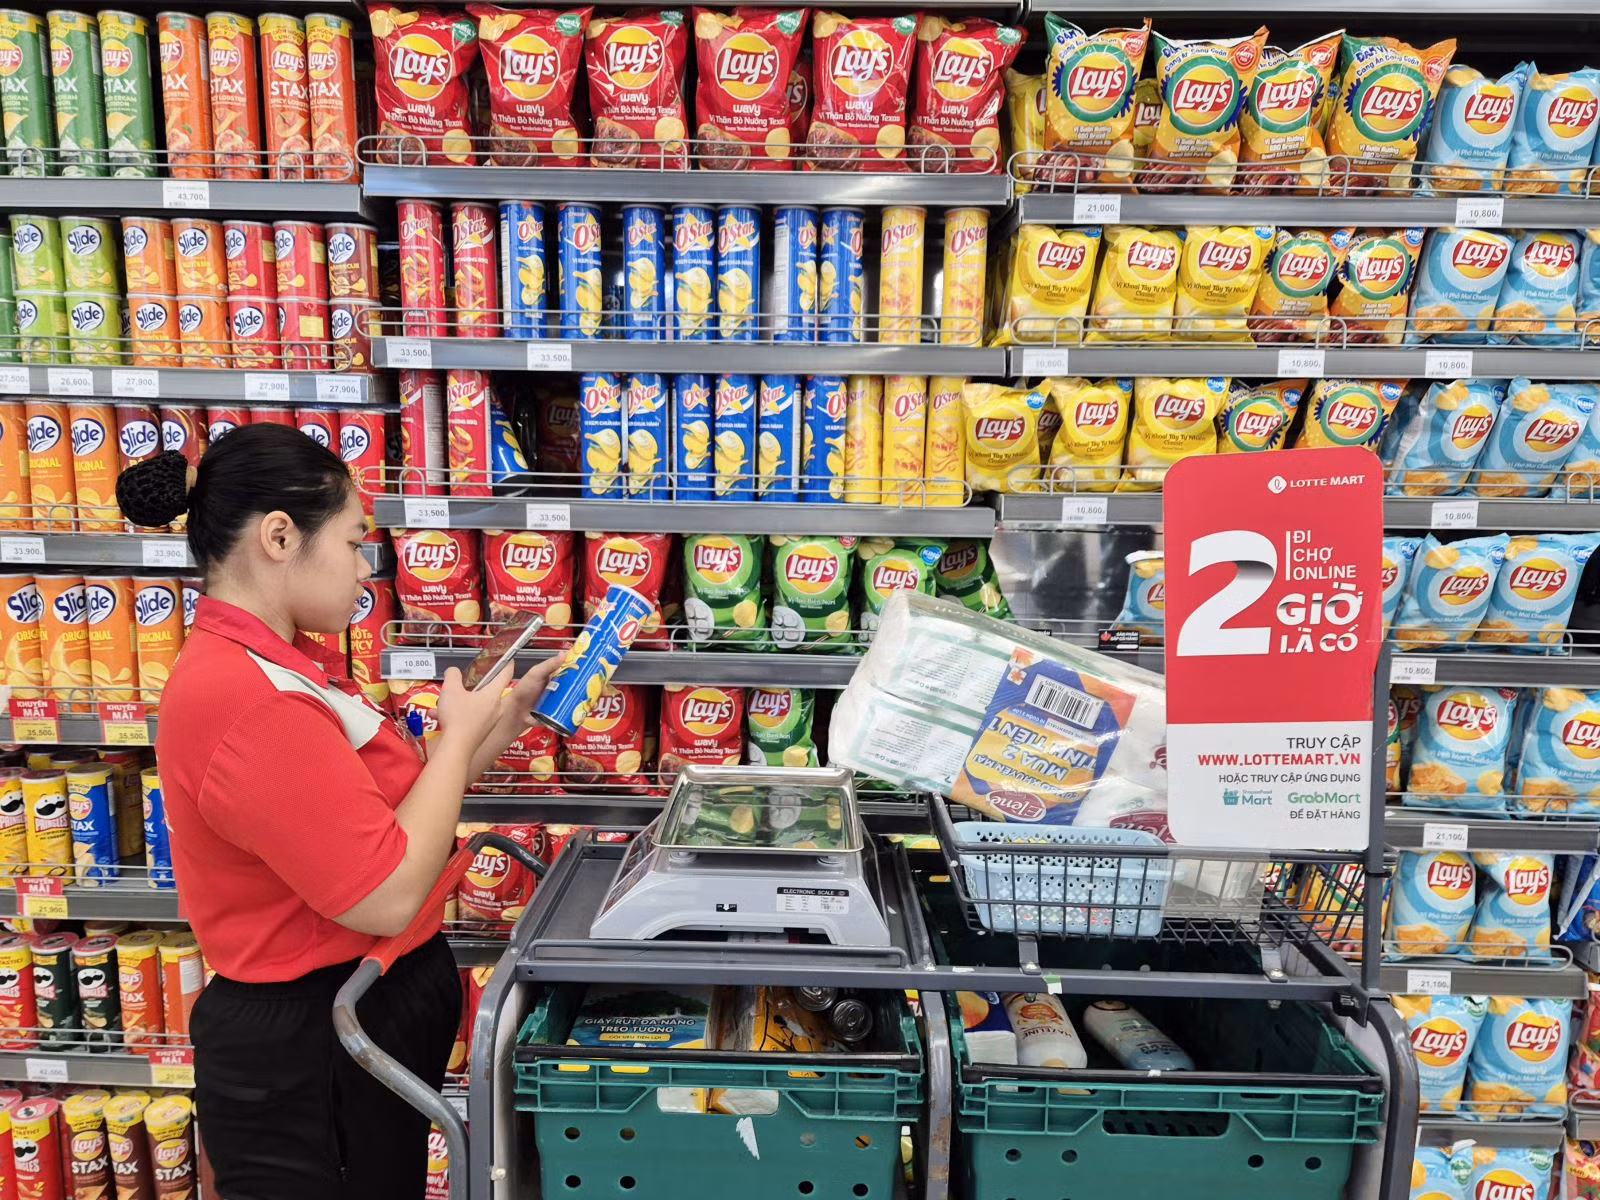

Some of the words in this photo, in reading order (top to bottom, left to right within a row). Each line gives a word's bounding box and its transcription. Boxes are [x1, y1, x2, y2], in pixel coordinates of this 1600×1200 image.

[394, 47, 449, 86] Lay's
[502, 47, 557, 86] Lay's
[608, 41, 661, 75] Lay's
[719, 48, 774, 86] Lay's
[840, 45, 890, 82] Lay's
[933, 51, 987, 87] Lay's
[271, 81, 311, 103] STAX
[1071, 67, 1124, 99] Lay's
[1175, 79, 1231, 113] Lay's
[1259, 80, 1315, 111] Lay's
[406, 103, 436, 118] wavy
[516, 103, 545, 118] wavy
[619, 92, 649, 107] wavy
[732, 103, 761, 118] wavy
[845, 101, 874, 115] wavy
[940, 104, 968, 118] wavy
[1362, 87, 1420, 119] Lay's
[1467, 93, 1512, 123] Lay's
[1551, 95, 1598, 125] Lay's
[67, 226, 99, 254] Slide
[329, 230, 356, 259] Slide
[627, 222, 656, 245] O'Star
[881, 222, 917, 254] O'Star
[950, 223, 987, 256] O'Star
[1039, 241, 1084, 270] Lay's
[1129, 241, 1176, 270] Lay's
[1200, 241, 1250, 270] Lay's
[1361, 254, 1405, 282] Lay's
[1455, 240, 1509, 268] Lay's
[1528, 242, 1573, 268] Lay's
[1281, 255, 1328, 282] Lay's
[71, 299, 102, 330] Slide
[136, 302, 167, 330] Slide
[233, 306, 262, 334] Slide
[1077, 401, 1118, 427] Lay's
[1155, 395, 1205, 422] Lay's
[1328, 402, 1377, 430] Lay's
[120, 424, 157, 452] Slide
[978, 418, 1022, 441] Lay's
[1238, 411, 1280, 439] Lay's
[1453, 414, 1492, 444] Lay's
[1527, 417, 1579, 445] Lay's
[1289, 479, 1327, 488] LOTTE
[1329, 475, 1365, 487] MART
[1292, 530, 1311, 544] ĐI
[406, 541, 458, 574] Lay's
[504, 541, 555, 574] Lay's
[599, 548, 648, 581] Lay's
[697, 545, 739, 574] Lay's
[1292, 546, 1333, 564] CHỢ
[788, 554, 837, 585] Lay's
[1292, 564, 1357, 581] ONLINE
[1511, 566, 1567, 593] Lay's
[421, 586, 447, 597] wavy
[515, 585, 542, 597] wavy
[1176, 529, 1278, 657] 2
[1440, 575, 1488, 597] Lay's
[1280, 626, 1314, 654] LÀ
[1319, 623, 1359, 653] CÓ
[684, 699, 733, 726] Lay's
[749, 692, 790, 718] Lay's
[1439, 700, 1498, 730] Lay's
[586, 735, 611, 746] wavy
[694, 739, 718, 750] wavy
[1004, 743, 1021, 760] 2
[1286, 737, 1327, 749] TRUY
[1329, 734, 1361, 752] CẬP
[1021, 751, 1068, 782] MUA
[1197, 753, 1361, 767] WWW.LOTTEMART.VN
[1218, 774, 1249, 785] HOẶC
[1250, 774, 1279, 784] TRUY
[1280, 772, 1303, 785] CẬP
[1303, 771, 1328, 784] ỨNG
[1329, 773, 1361, 786] DỤNG
[1242, 795, 1273, 806] Mart
[1287, 791, 1361, 805] GrabMart
[1290, 808, 1304, 819] ĐỂ
[1305, 810, 1328, 822] ĐẶT
[1329, 808, 1361, 820] HÀNG
[1429, 861, 1473, 890] Lay's
[1506, 866, 1549, 896] Lay's
[783, 888, 816, 896] ELECTRONIC
[818, 889, 835, 897] SCALE
[600, 1025, 629, 1034] TREO
[1413, 1026, 1467, 1058] Lay's
[1509, 1022, 1560, 1053] Lay's
[71, 1157, 109, 1176] STAX
[155, 1160, 193, 1182] STAX
